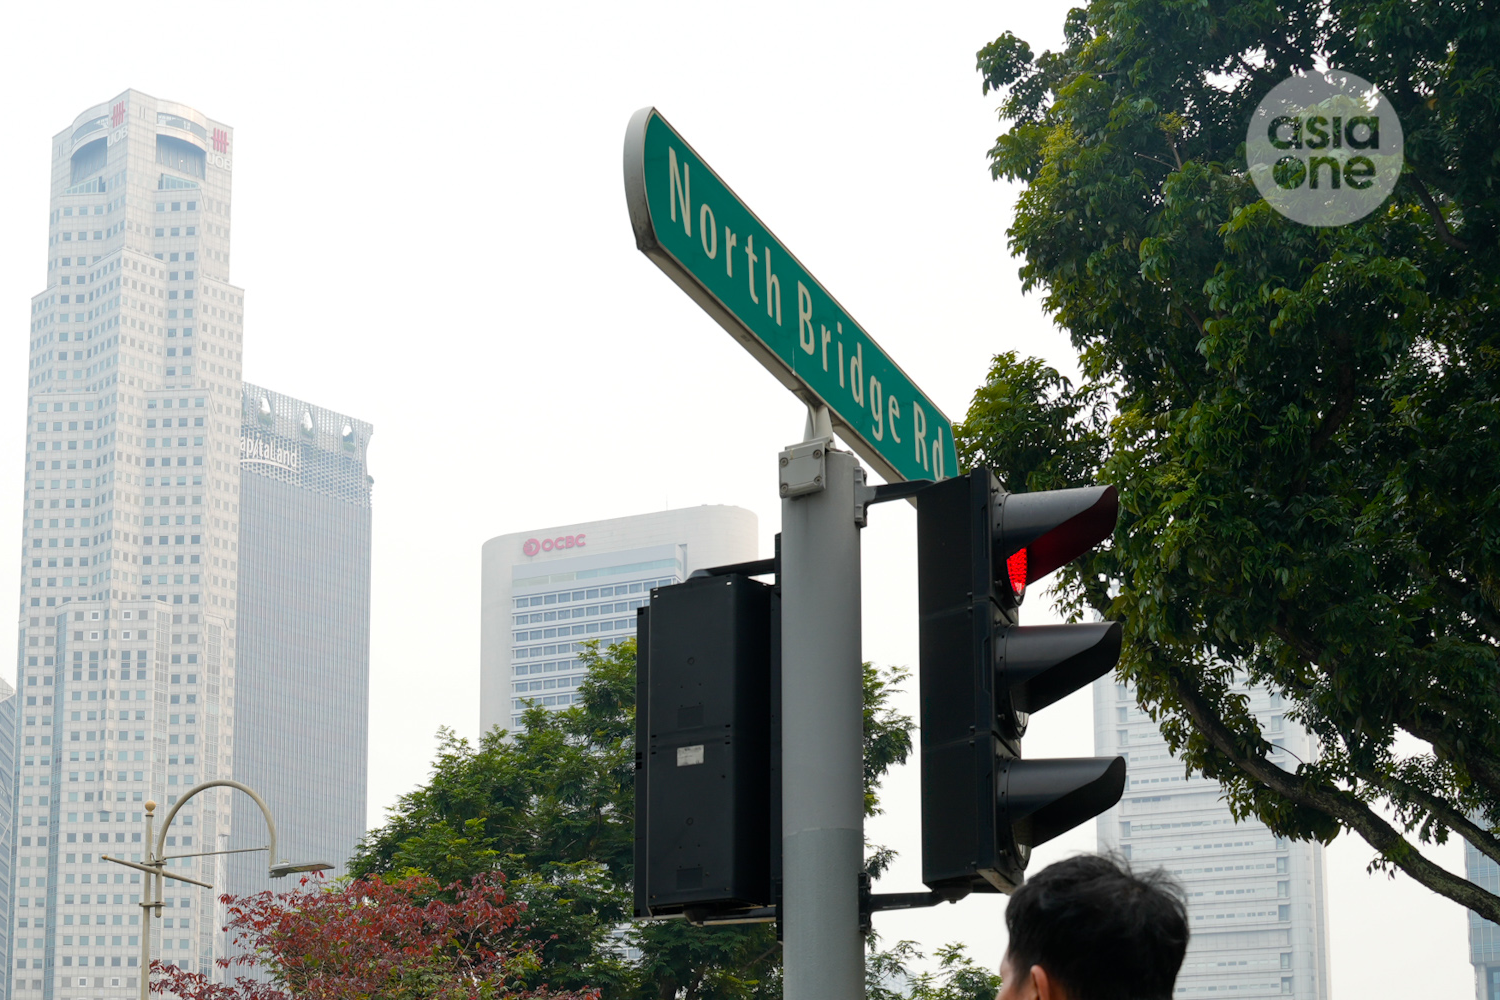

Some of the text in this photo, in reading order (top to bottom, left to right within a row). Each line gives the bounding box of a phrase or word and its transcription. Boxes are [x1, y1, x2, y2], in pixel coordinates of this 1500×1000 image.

[206, 151, 233, 172] UOB
[668, 145, 945, 482] North Bridge Rd
[240, 432, 297, 468] apitaLand
[541, 533, 587, 552] OCBC
